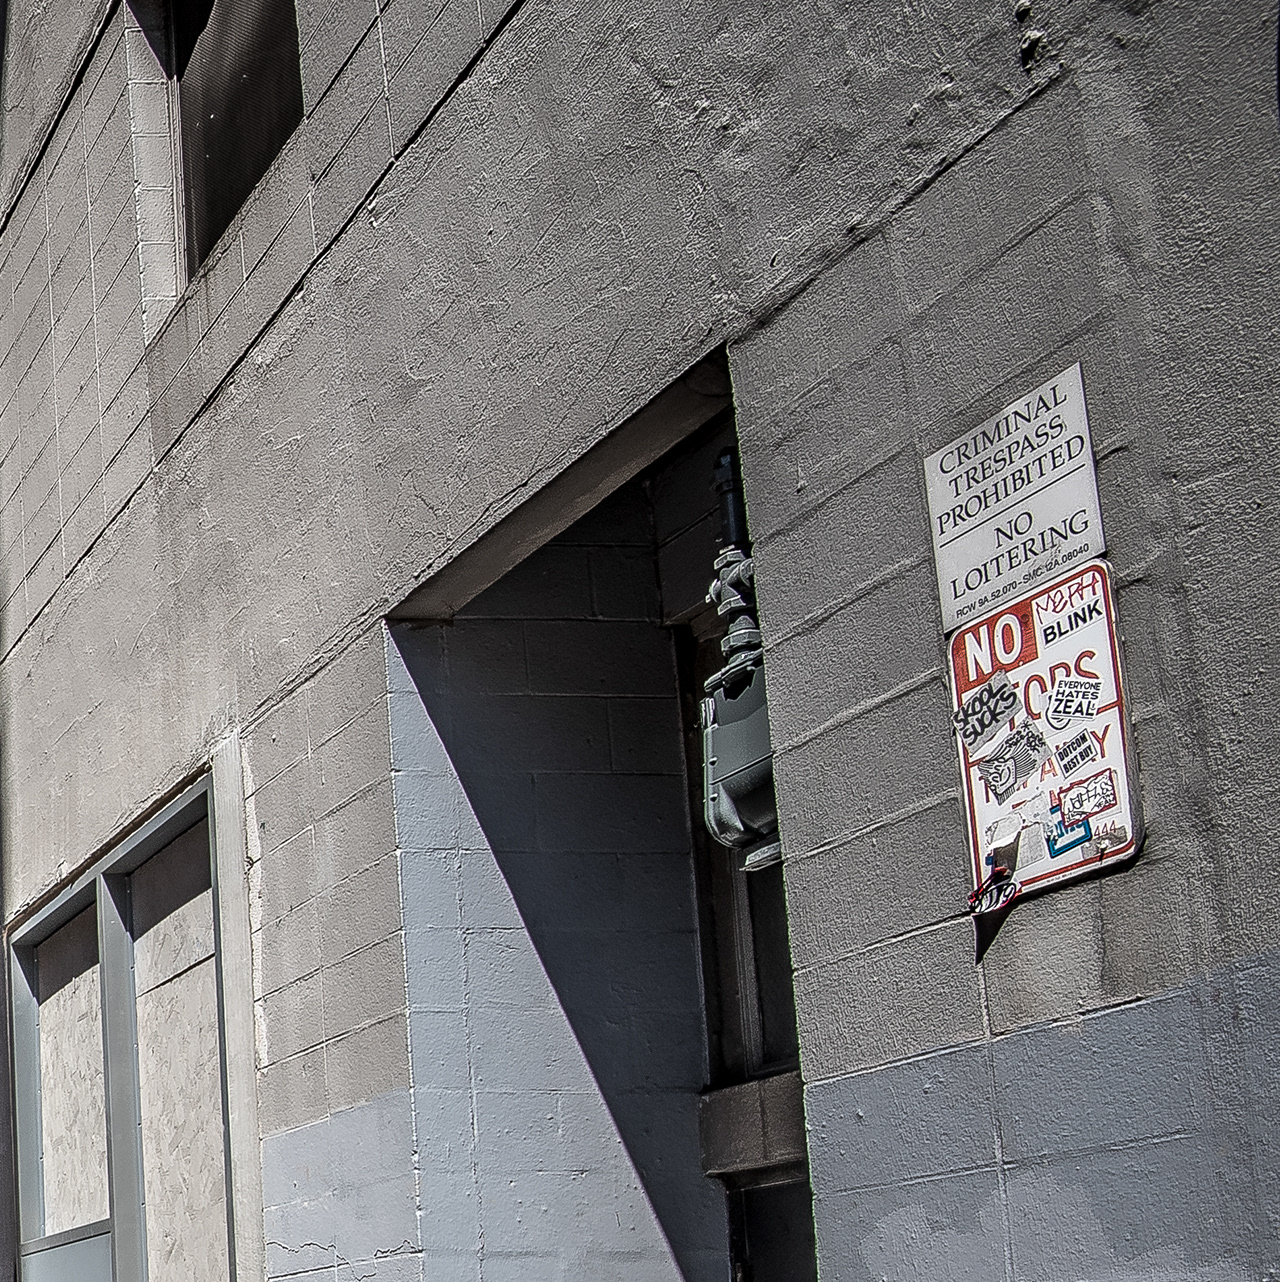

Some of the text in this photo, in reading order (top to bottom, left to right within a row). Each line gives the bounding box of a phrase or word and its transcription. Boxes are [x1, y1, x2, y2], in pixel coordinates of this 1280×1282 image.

[939, 384, 1068, 474] CRIMINAL
[949, 414, 1064, 499] TRESPASS
[937, 434, 1085, 537] PROHIBITED
[994, 511, 1033, 549] NO
[950, 509, 1089, 600] LOITERING
[956, 601, 976, 619] RCW
[1043, 599, 1104, 645] BLINK
[964, 613, 1023, 683] NO
[1055, 690, 1099, 699] HATES
[1057, 680, 1102, 691] EVERYONE
[1058, 733, 1088, 762] DOTCOM
[1063, 745, 1093, 774] BEST BUY
